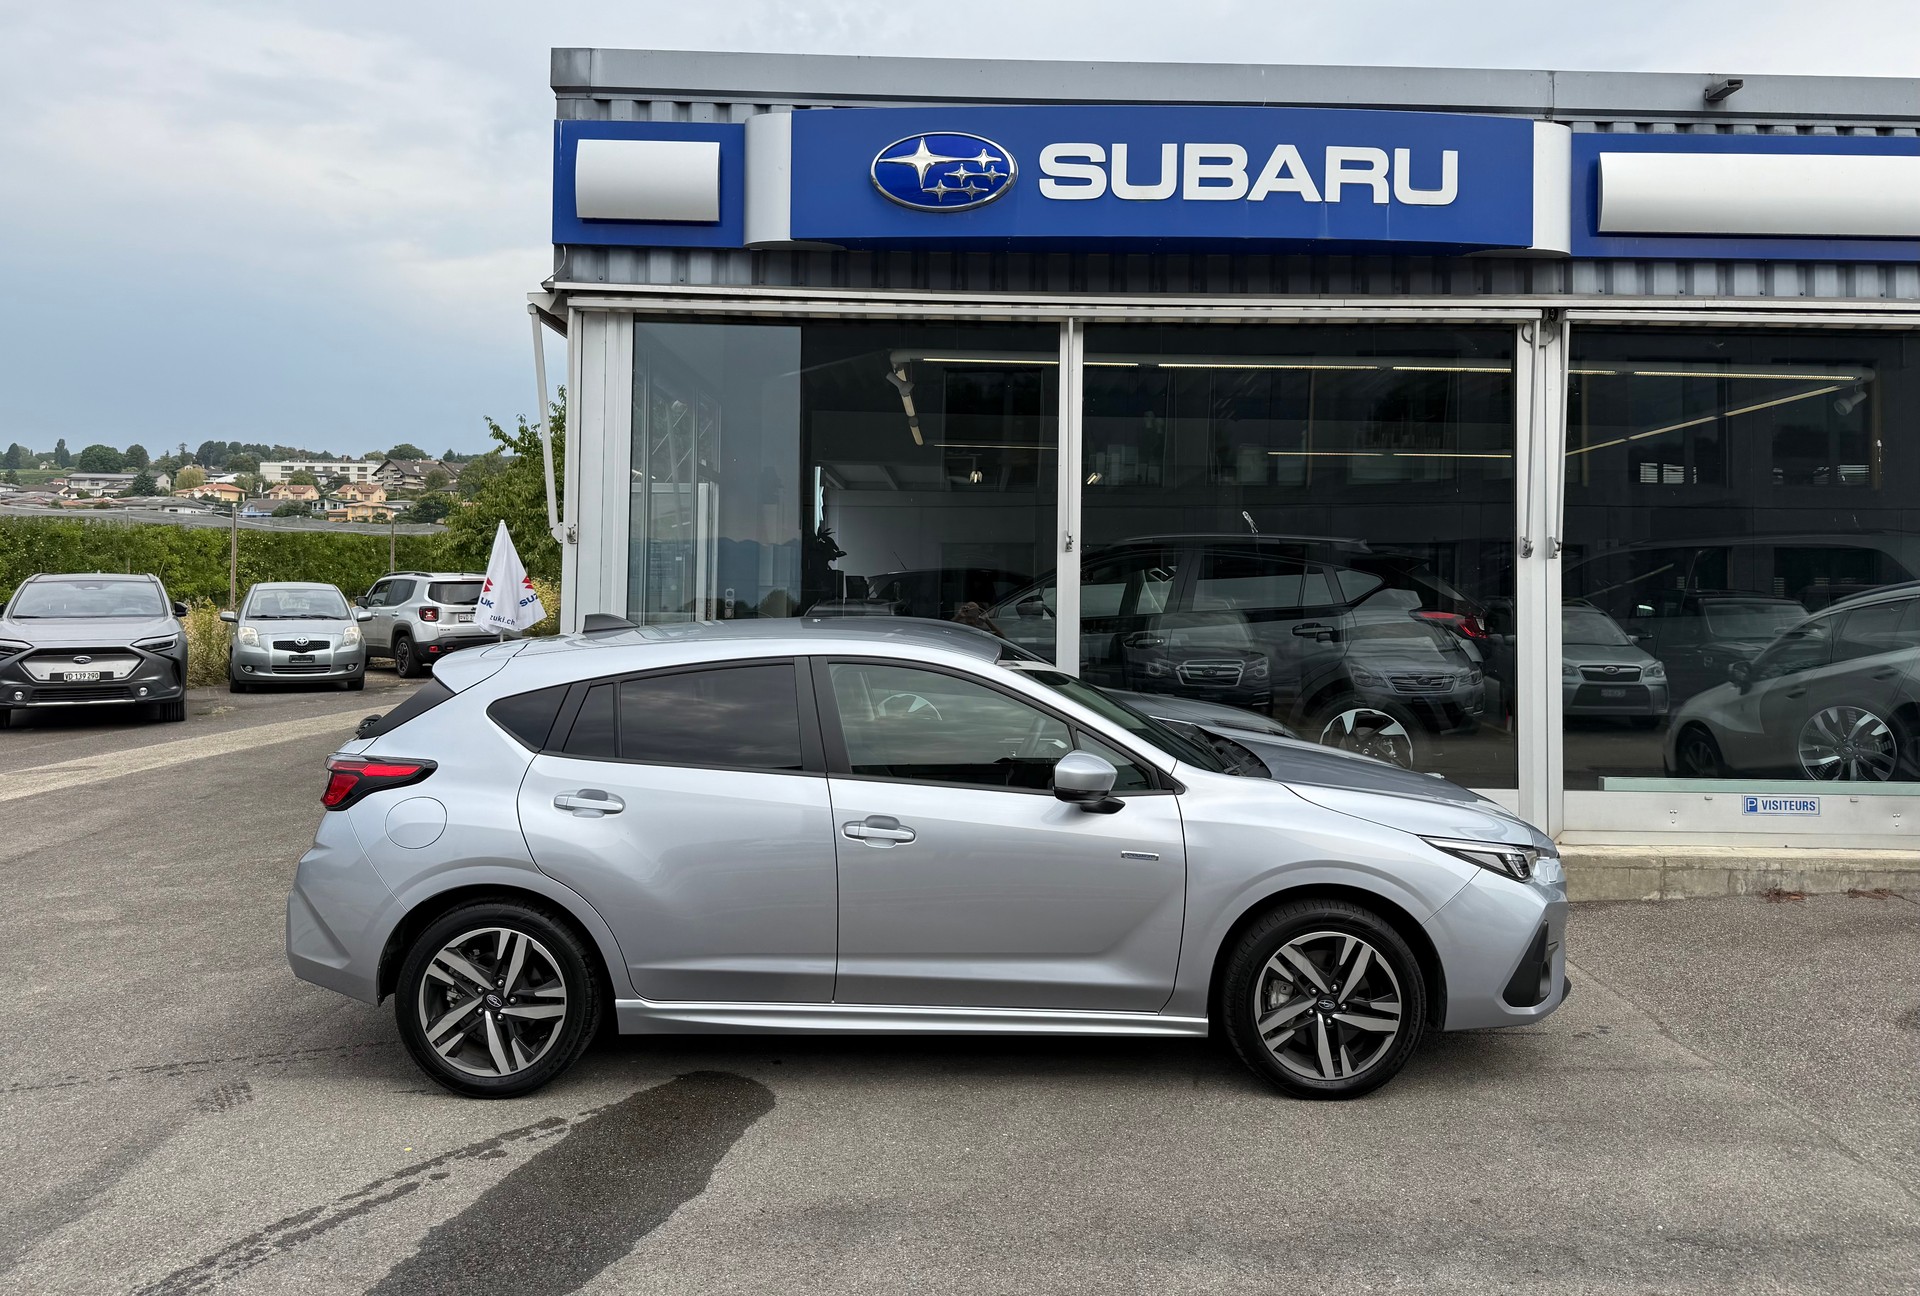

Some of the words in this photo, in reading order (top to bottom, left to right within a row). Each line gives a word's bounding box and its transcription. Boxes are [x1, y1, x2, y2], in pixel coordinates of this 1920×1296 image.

[1038, 142, 1459, 206] SUBARU
[65, 672, 74, 680] VD
[1761, 799, 1816, 811] VISITEURS
